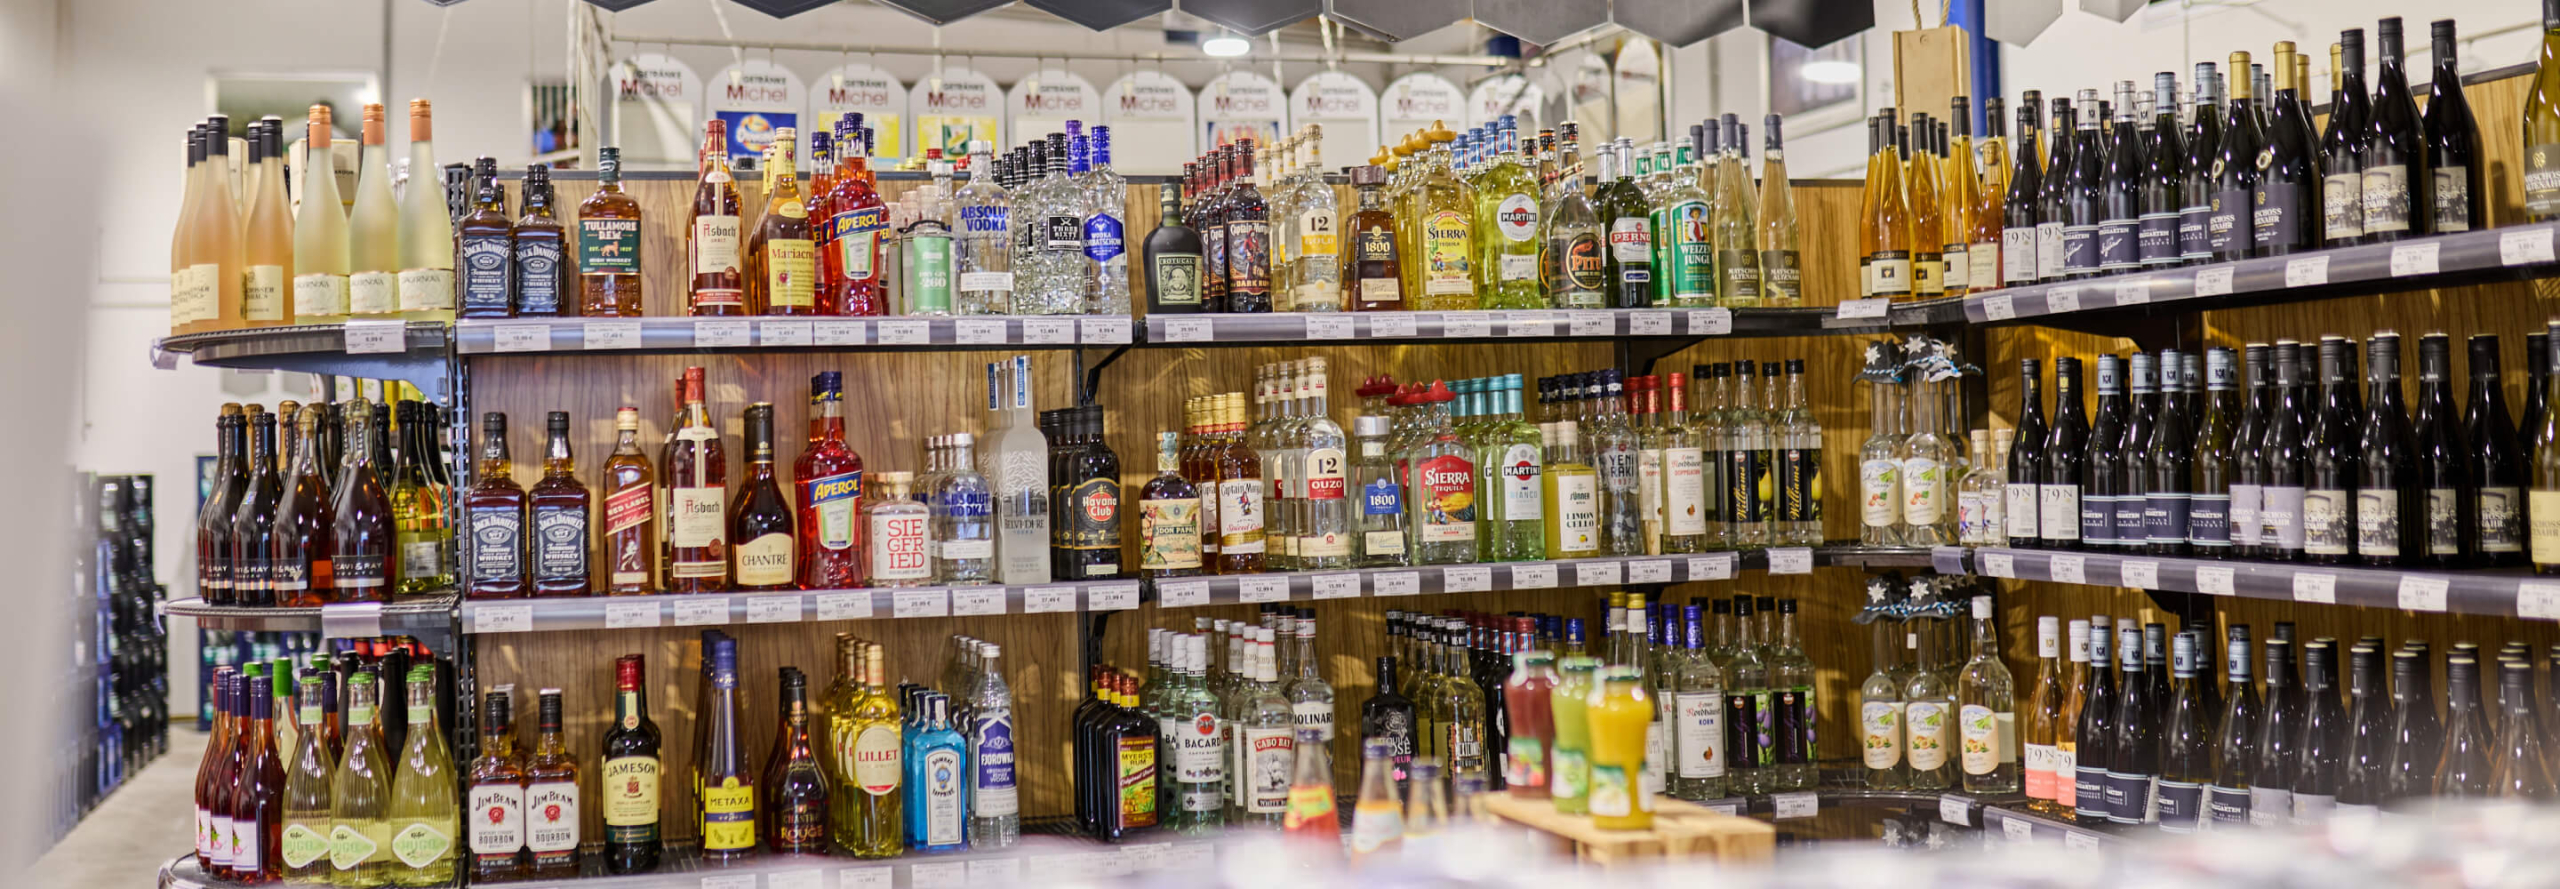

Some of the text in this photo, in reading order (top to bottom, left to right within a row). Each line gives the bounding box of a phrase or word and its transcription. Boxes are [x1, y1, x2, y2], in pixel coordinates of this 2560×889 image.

[743, 74, 786, 85] GETRÄNKE
[845, 80, 888, 88] GETRÄNKE
[621, 79, 682, 98] Michel
[727, 84, 788, 102] Michel
[830, 88, 888, 106] Michel
[928, 91, 986, 108] Michel
[1026, 94, 1082, 110] Michel
[1121, 95, 1176, 112] Michel
[1216, 96, 1270, 112] Michel
[1307, 97, 1360, 112] Michel
[1398, 98, 1450, 113] Michel
[836, 214, 879, 234] APEROL
[1310, 216, 1328, 231] 12
[1502, 213, 1536, 223] MARTINI
[584, 221, 637, 231] TULLAMORE
[703, 222, 737, 238] Asbach
[966, 219, 1007, 232] VODKA
[1230, 223, 1252, 235] Captain
[1428, 226, 1467, 240] SIERRA
[2004, 230, 2019, 245] 79
[2039, 226, 2054, 241] 79
[464, 244, 482, 258] JACK
[1365, 242, 1390, 252] 1800
[516, 248, 534, 261] JACK
[1318, 458, 1337, 474] 12
[1504, 466, 1540, 475] MARTINI
[1425, 469, 1470, 485] SIERRA
[814, 478, 858, 501] APEROL
[1220, 484, 1244, 497] Captain
[1312, 481, 1343, 489] OUZO
[944, 493, 989, 505] ABSOLUT
[1370, 495, 1395, 506] 1800
[2044, 488, 2072, 500] 79 N
[607, 496, 651, 516] RED LABEL
[685, 500, 720, 514] Asbach
[1083, 497, 1116, 506] Havana
[950, 505, 986, 516] VODKA
[1090, 506, 1111, 517] Club
[1567, 512, 1594, 520] LIMON
[473, 518, 491, 532] JACK
[539, 519, 557, 532] JACK
[887, 518, 923, 537] SIE
[1004, 519, 1044, 530] BELVEDERE
[1159, 526, 1174, 535] DON
[1566, 520, 1594, 528] CELLO
[887, 537, 923, 552] GFR
[743, 553, 787, 566] CHANTRÉ
[889, 552, 924, 569] IED
[252, 566, 269, 574] RAY
[285, 565, 301, 573] RAY
[1256, 738, 1290, 749] CABO BAY
[858, 750, 898, 761] LILLET
[2027, 748, 2041, 762] 79
[2058, 754, 2071, 768] 79
[608, 763, 656, 777] JAMESON
[476, 792, 517, 811] JIM BEAM
[532, 791, 573, 809] JIM BEAM
[710, 796, 750, 806] METAXA
[479, 834, 514, 844] BOURBON
[536, 832, 571, 842] BOURBON
[781, 826, 823, 839] ROUGE
